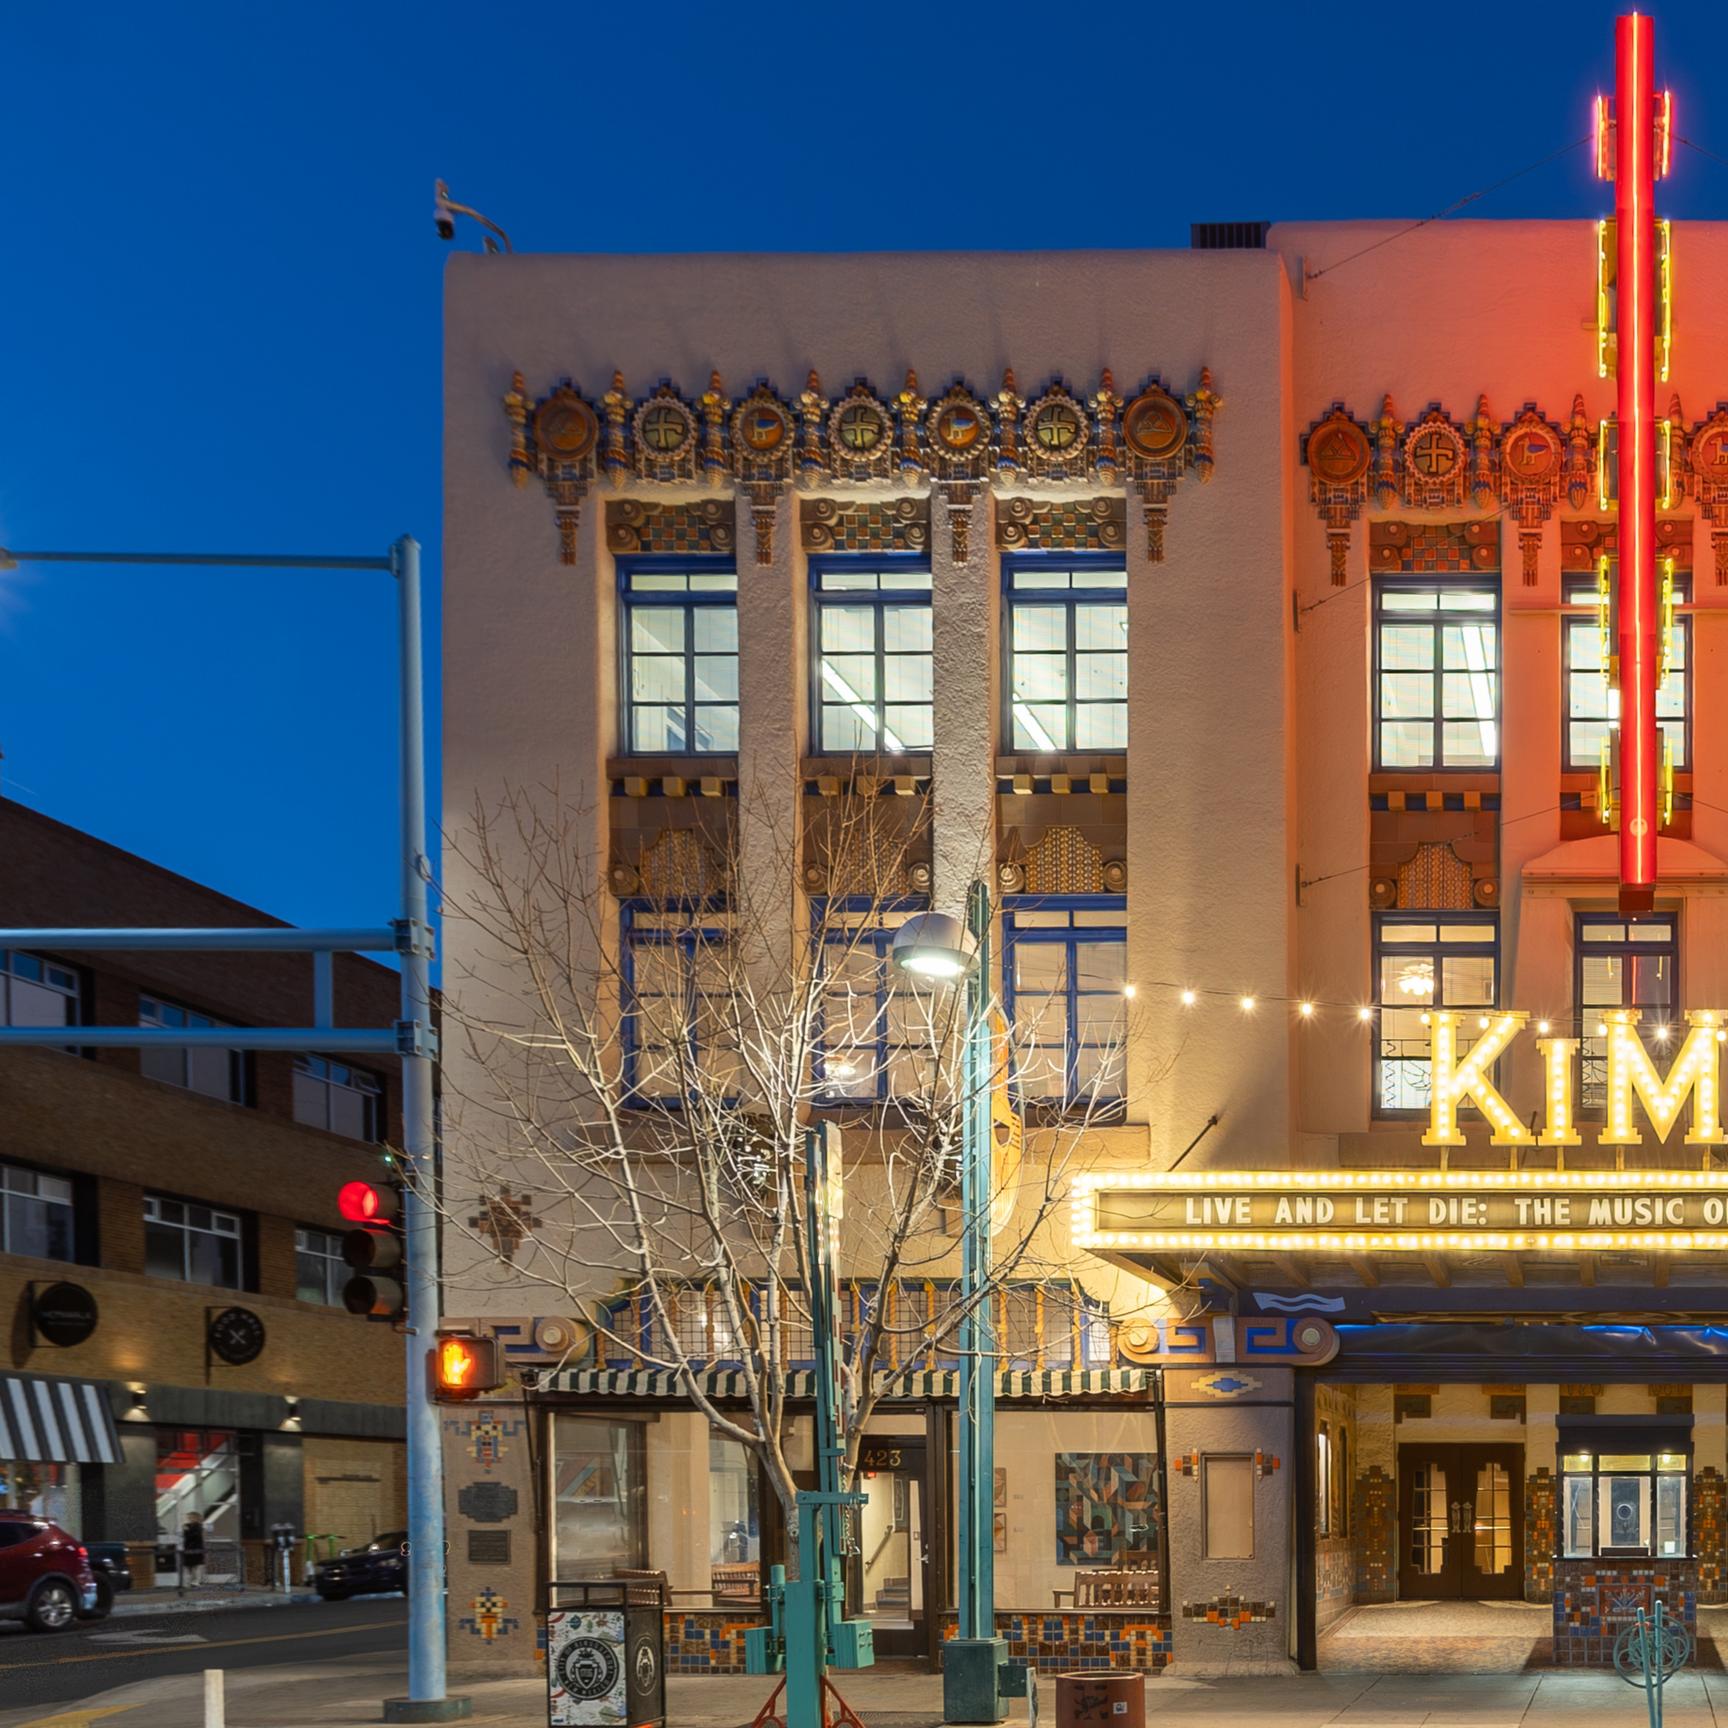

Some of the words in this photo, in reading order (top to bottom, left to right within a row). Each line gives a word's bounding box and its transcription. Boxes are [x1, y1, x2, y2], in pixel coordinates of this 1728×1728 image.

[1185, 1197, 1252, 1224] LIVE
[1274, 1197, 1335, 1224] AND
[1355, 1197, 1408, 1224] LET
[1429, 1197, 1487, 1224] DIE:
[1514, 1197, 1570, 1224] THE
[1588, 1197, 1684, 1225] MUSIC
[864, 1450, 901, 1467] 423
